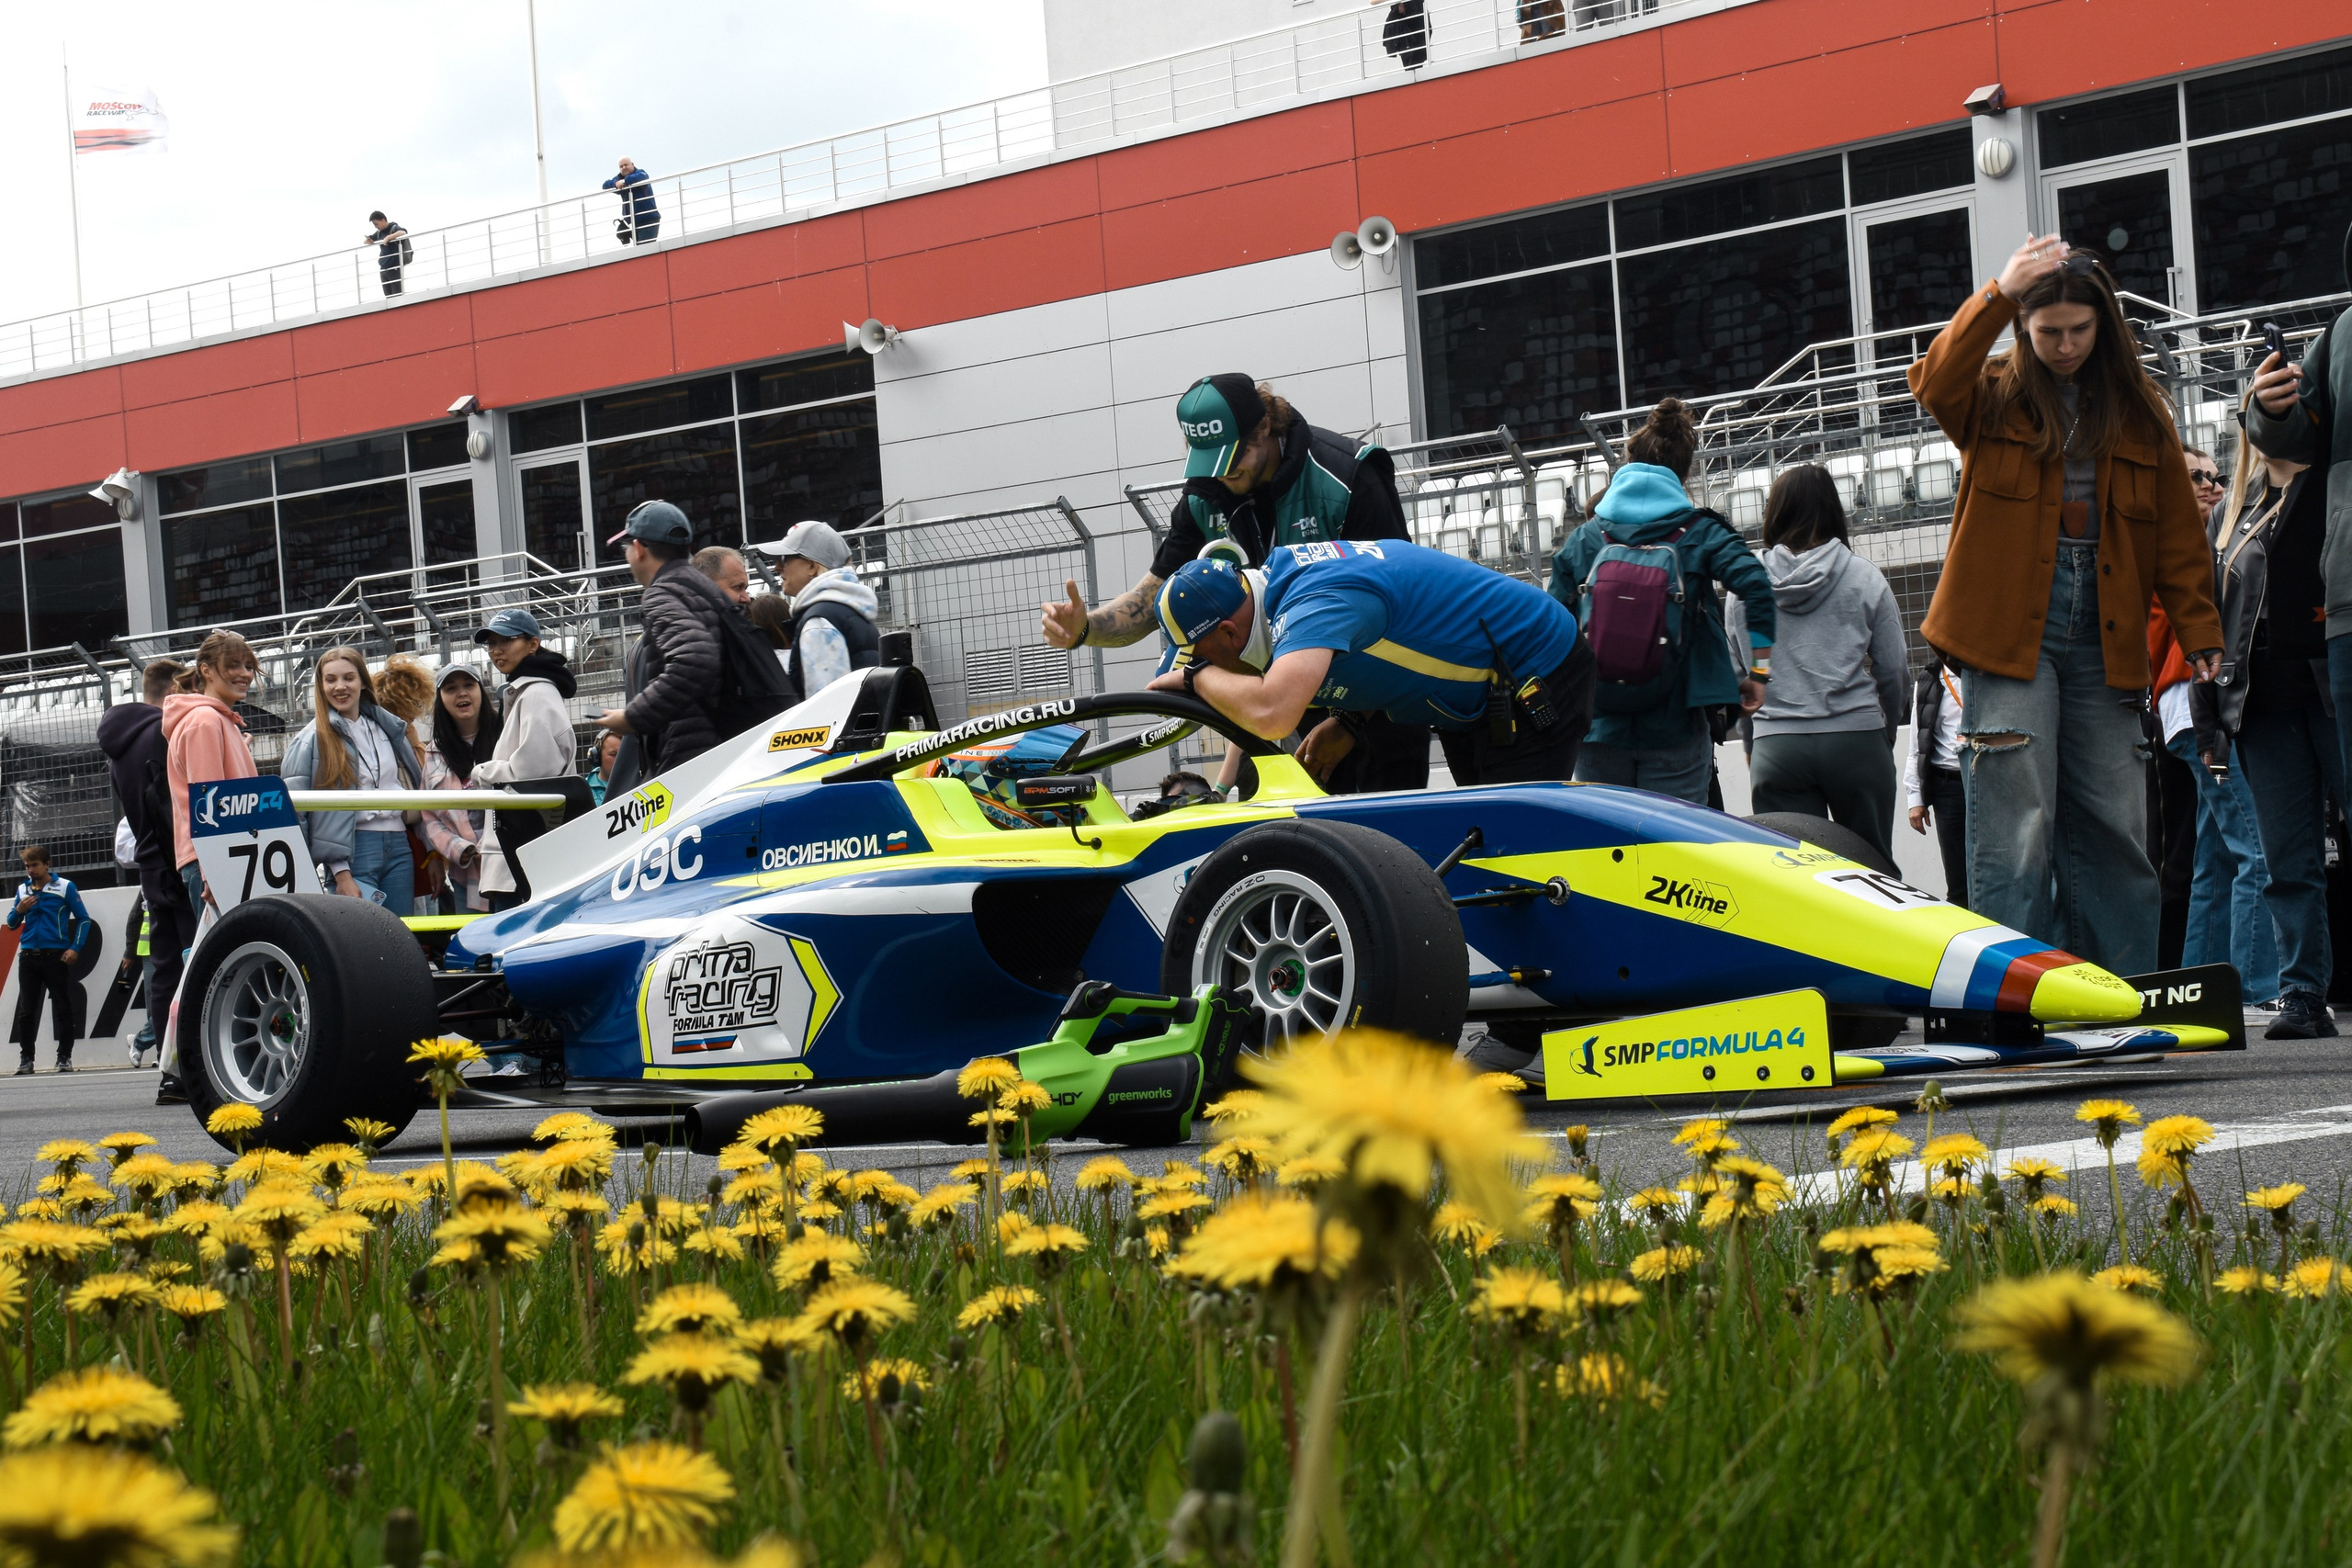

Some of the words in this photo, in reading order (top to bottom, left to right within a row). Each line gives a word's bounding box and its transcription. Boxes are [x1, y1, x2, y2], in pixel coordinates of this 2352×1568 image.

[89, 102, 142, 110] MOSCOW
[1180, 419, 1224, 437] ITECO
[772, 730, 826, 749] SHONX
[895, 698, 1077, 763] PRIMARACING.RU
[605, 795, 665, 840] 2Kline
[762, 836, 862, 871] ОВСИЕНКО
[229, 840, 296, 905] 79
[1830, 873, 1942, 906] 79
[1213, 885, 1243, 918] RACING
[1644, 875, 1729, 915] 2Kline
[664, 940, 755, 998] prima
[668, 964, 783, 1019] racing
[2167, 982, 2202, 1006] NG
[1108, 1087, 1172, 1105] greenworks
